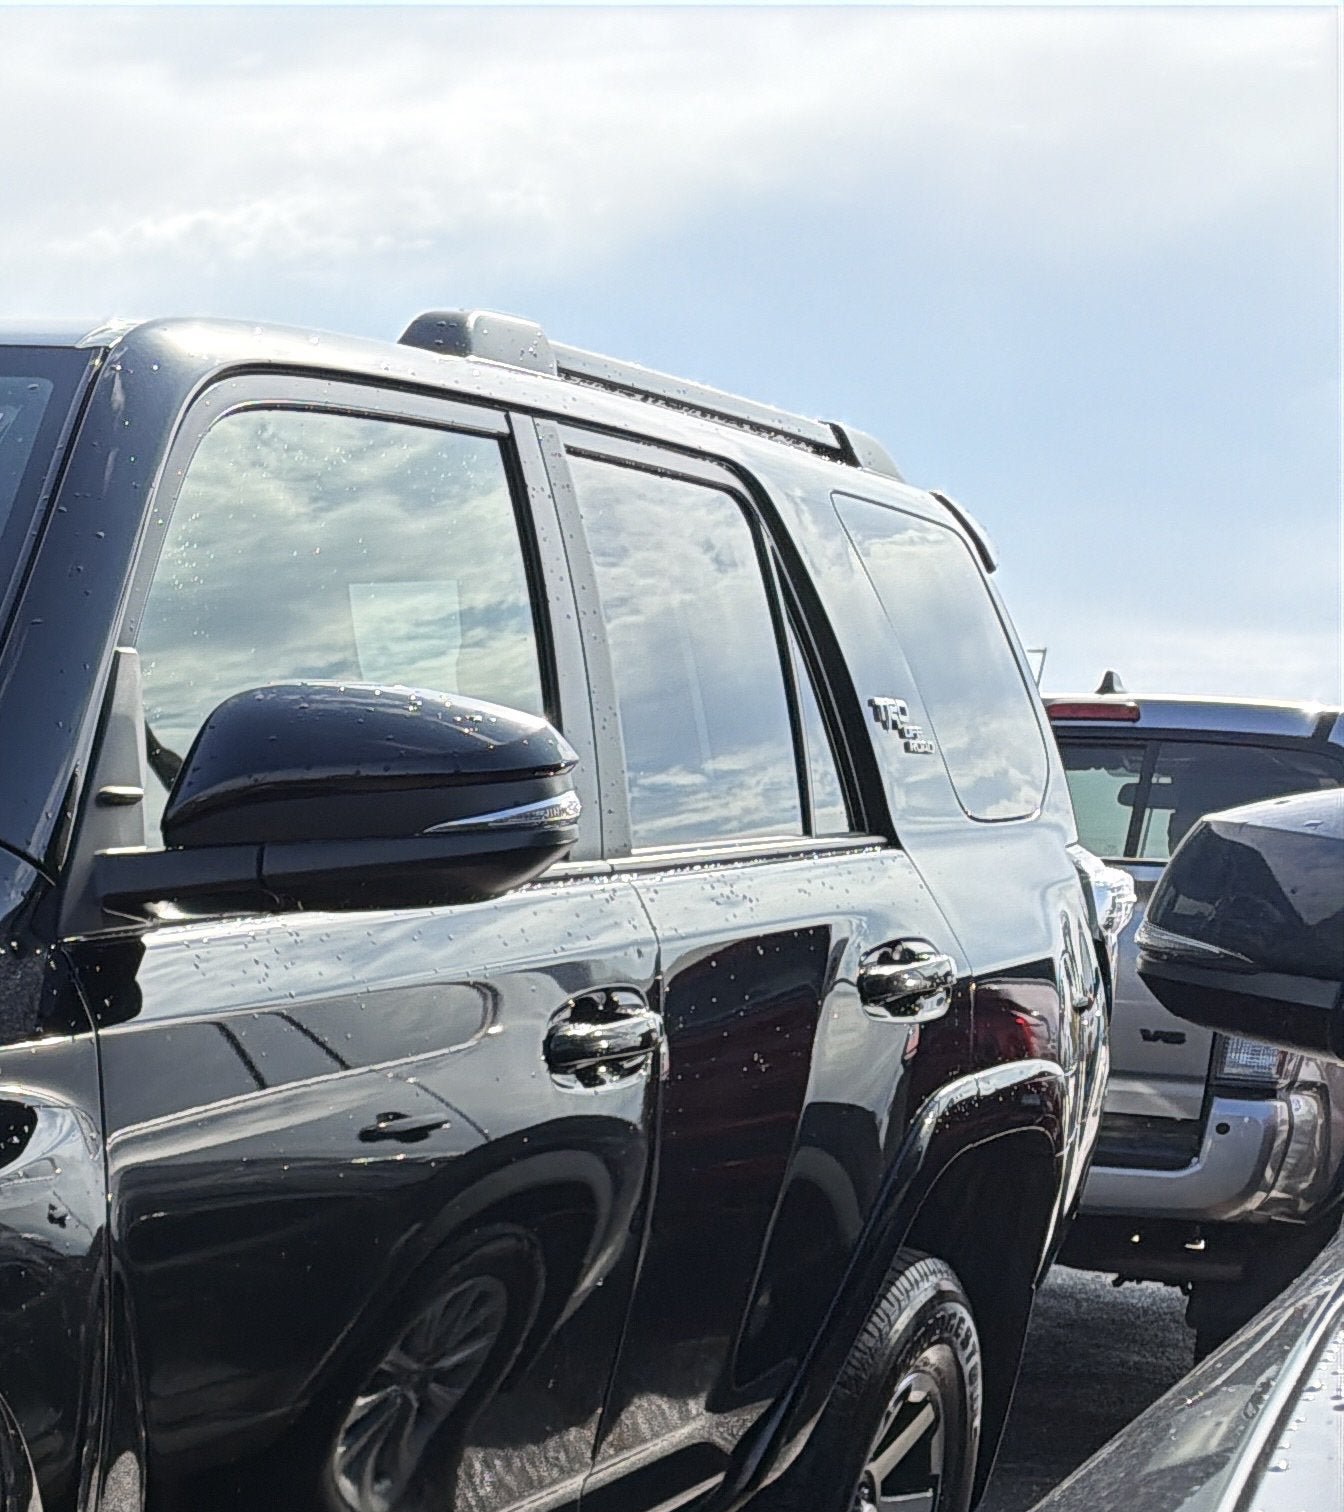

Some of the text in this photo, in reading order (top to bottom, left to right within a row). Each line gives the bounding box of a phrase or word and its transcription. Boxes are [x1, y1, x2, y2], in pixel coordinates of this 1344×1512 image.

[868, 696, 910, 732] TRD
[898, 725, 924, 740] OFF
[903, 740, 936, 755] ROAD
